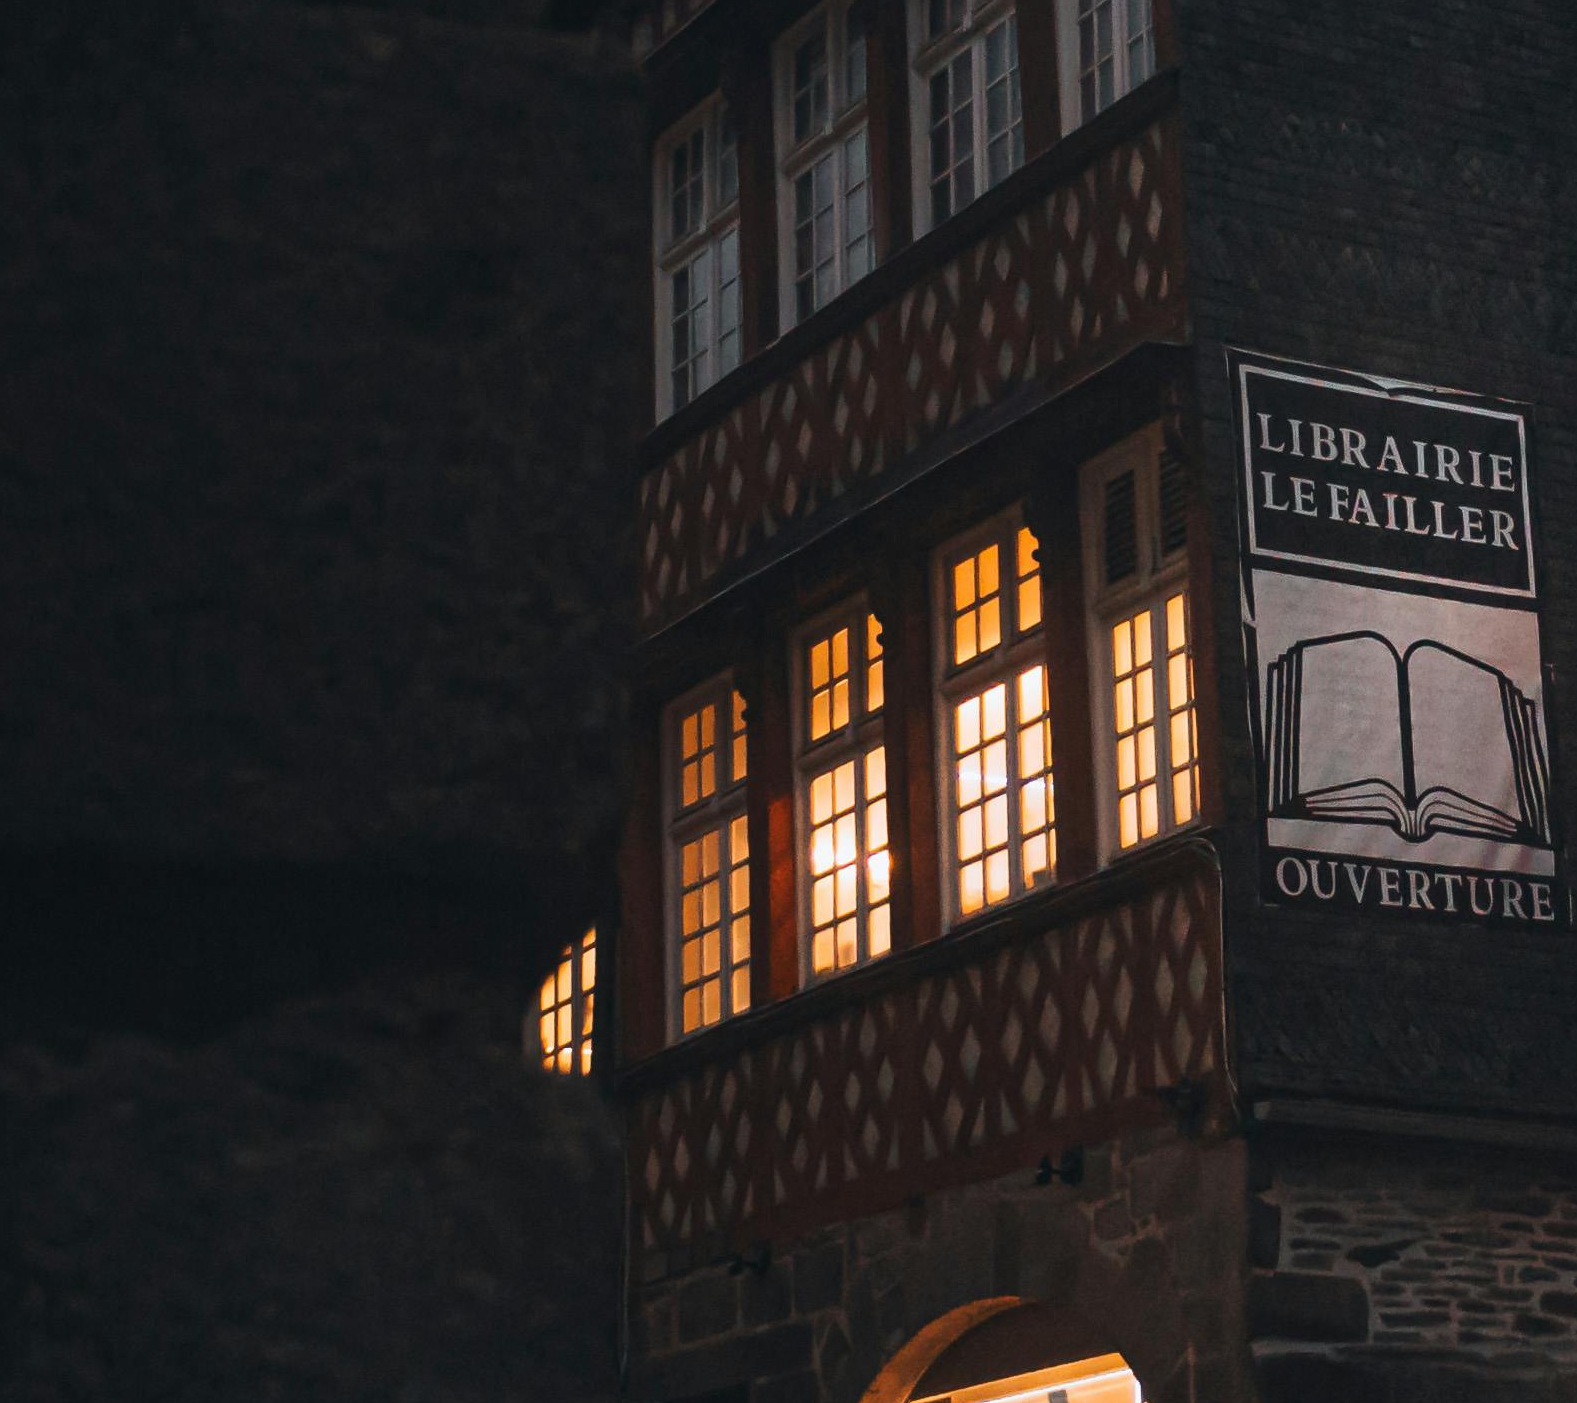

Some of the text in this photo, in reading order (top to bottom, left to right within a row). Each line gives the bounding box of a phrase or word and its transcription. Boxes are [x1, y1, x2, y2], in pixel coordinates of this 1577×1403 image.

[1257, 412, 1517, 494] LIBRAIRIE
[1260, 471, 1520, 552] LE FAILLER
[1276, 856, 1556, 923] OUVERTURE
